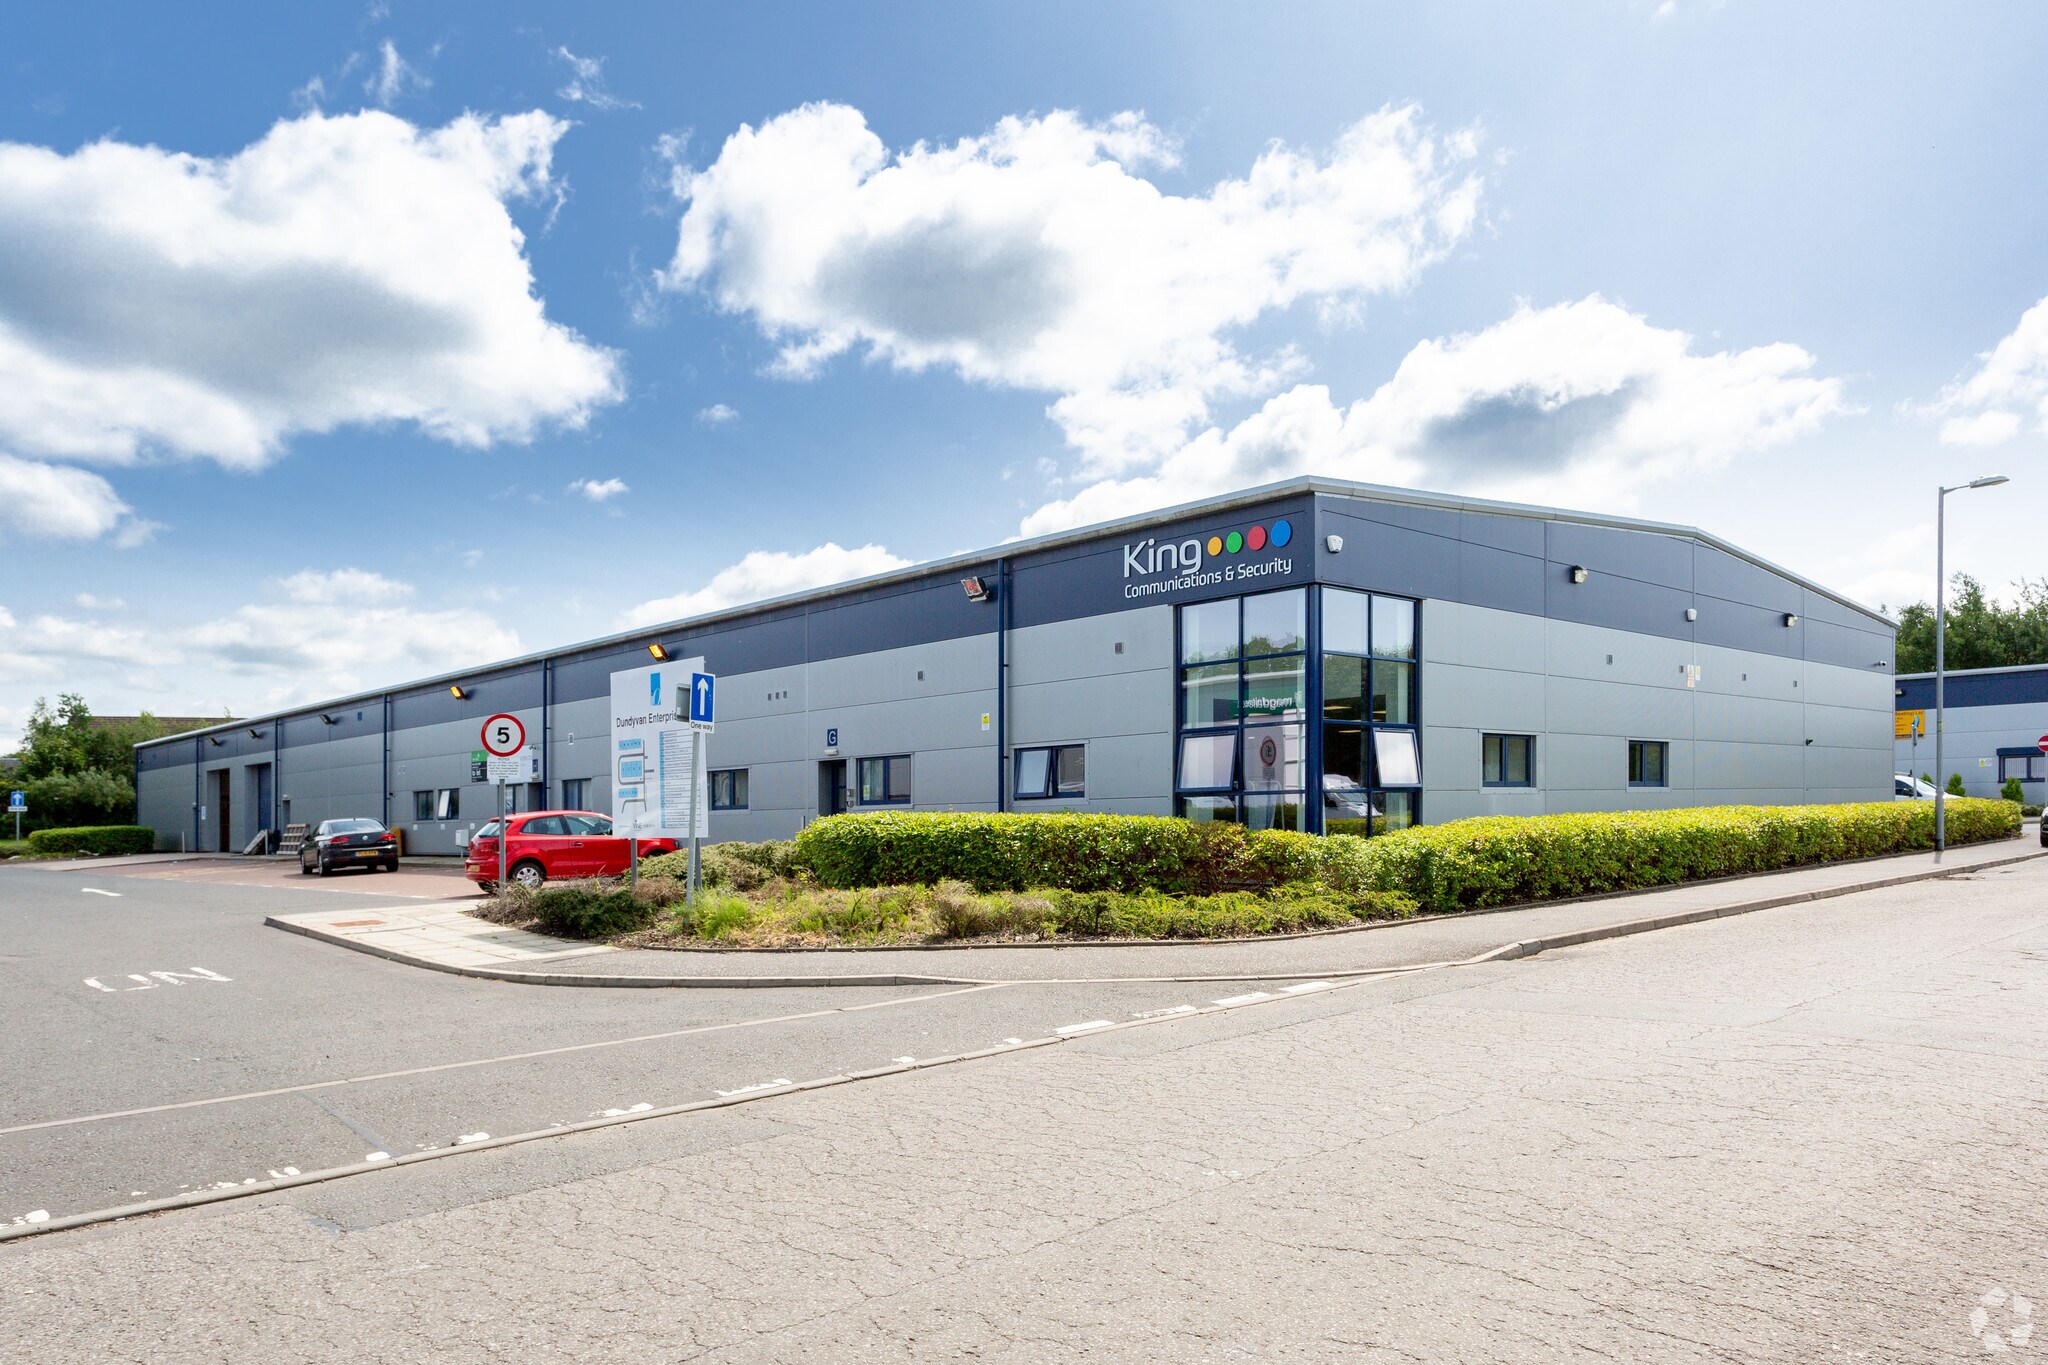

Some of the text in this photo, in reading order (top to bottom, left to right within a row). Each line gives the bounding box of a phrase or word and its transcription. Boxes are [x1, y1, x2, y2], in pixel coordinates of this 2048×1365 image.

[1123, 538, 1202, 578] King
[1124, 557, 1292, 599] Communications & Security
[616, 715, 647, 729] Dundyvan
[690, 721, 713, 732] One way
[497, 727, 510, 744] 5
[828, 731, 836, 744] G
